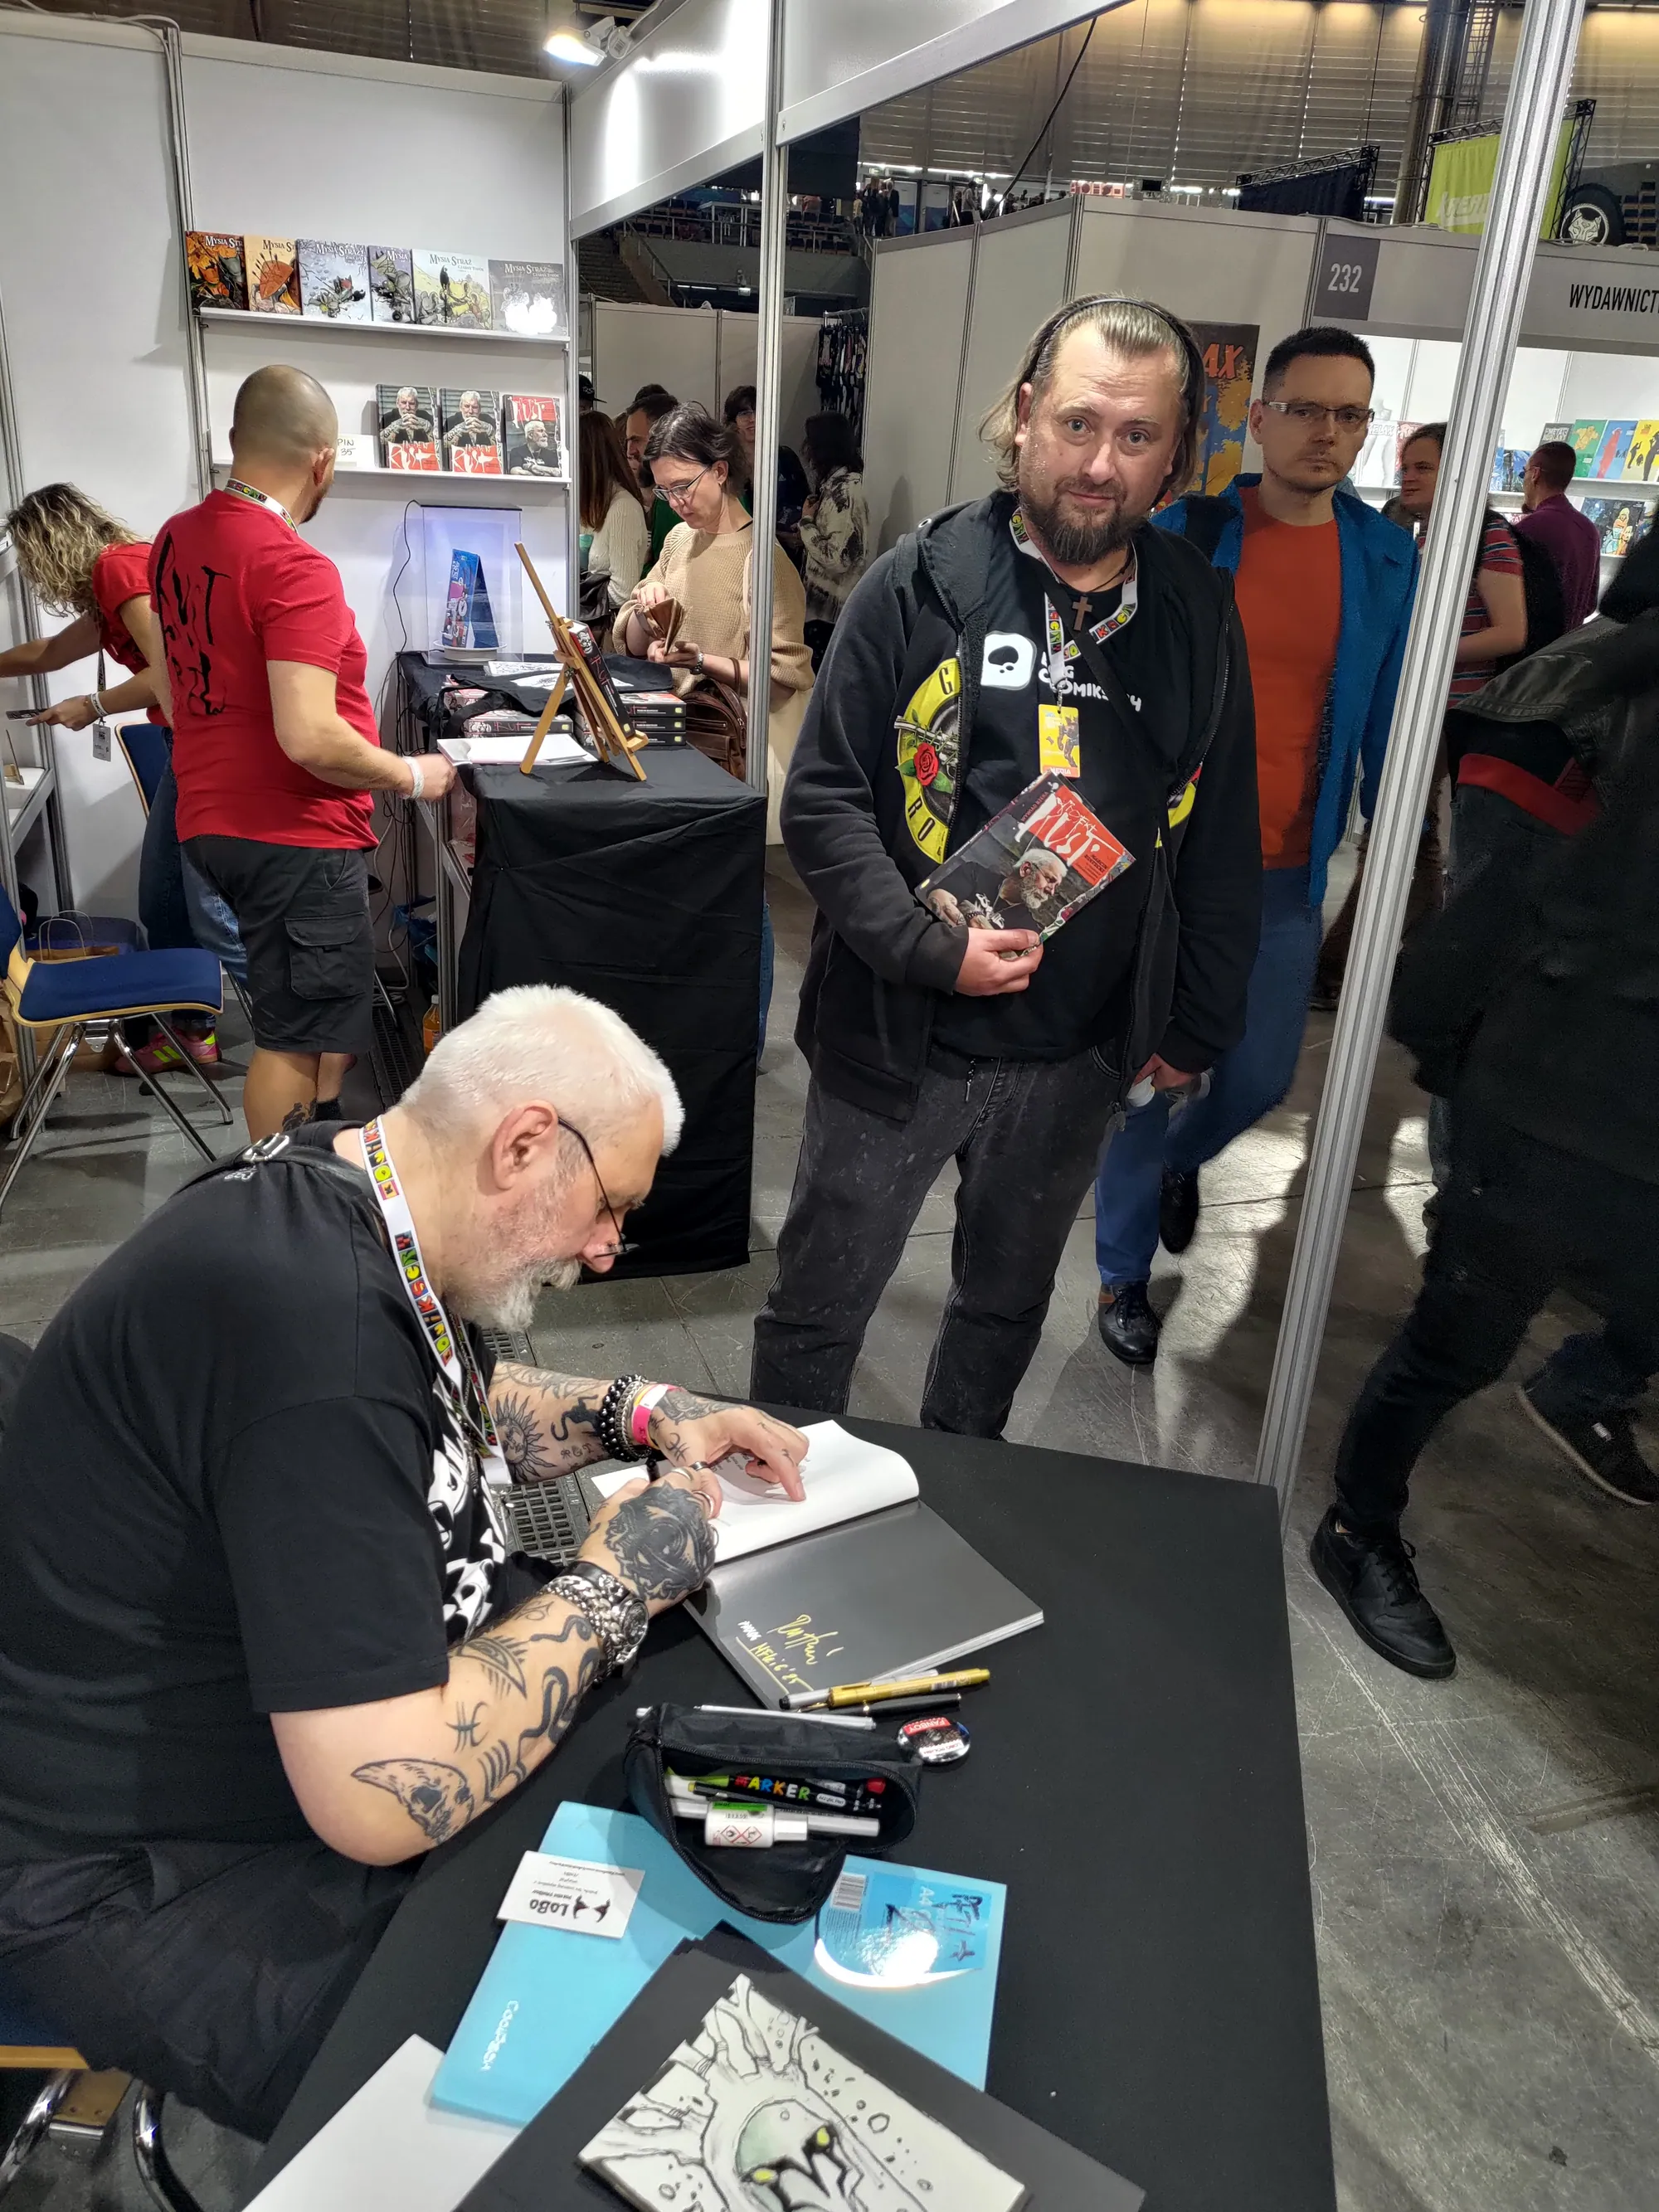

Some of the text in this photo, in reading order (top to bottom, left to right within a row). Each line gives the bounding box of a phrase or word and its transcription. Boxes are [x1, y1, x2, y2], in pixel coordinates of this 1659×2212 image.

[229, 237, 244, 249] STR
[1327, 263, 1362, 293] 232
[1569, 284, 1659, 314] WYDAWNICT
[908, 1719, 946, 1732] FANBOY
